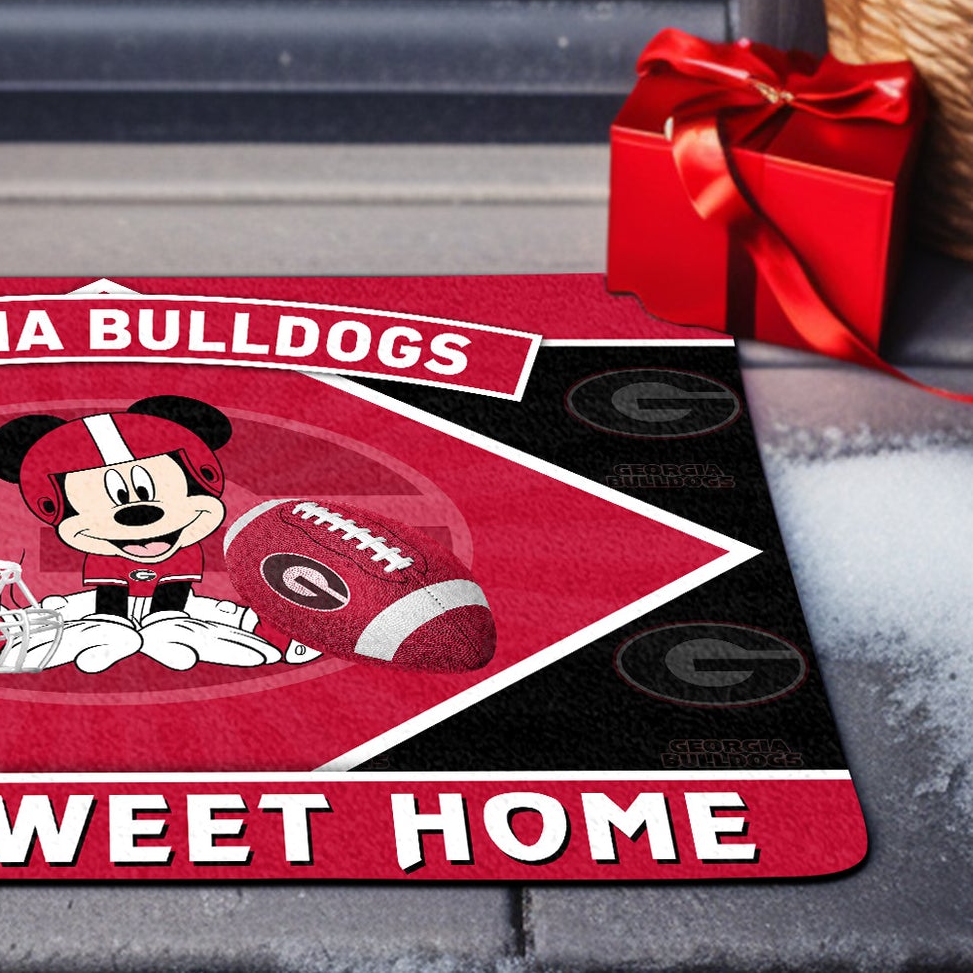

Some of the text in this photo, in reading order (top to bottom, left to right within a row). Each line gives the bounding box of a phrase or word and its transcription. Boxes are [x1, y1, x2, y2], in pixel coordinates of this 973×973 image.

[90, 309, 472, 376] BULLDOGS
[613, 464, 725, 476] GEORGIA
[605, 475, 736, 489] BULLDOGS
[282, 565, 348, 603] G
[668, 739, 791, 753] GEORGIA
[661, 752, 804, 768] BULLDOGS
[391, 791, 761, 874] HOME
